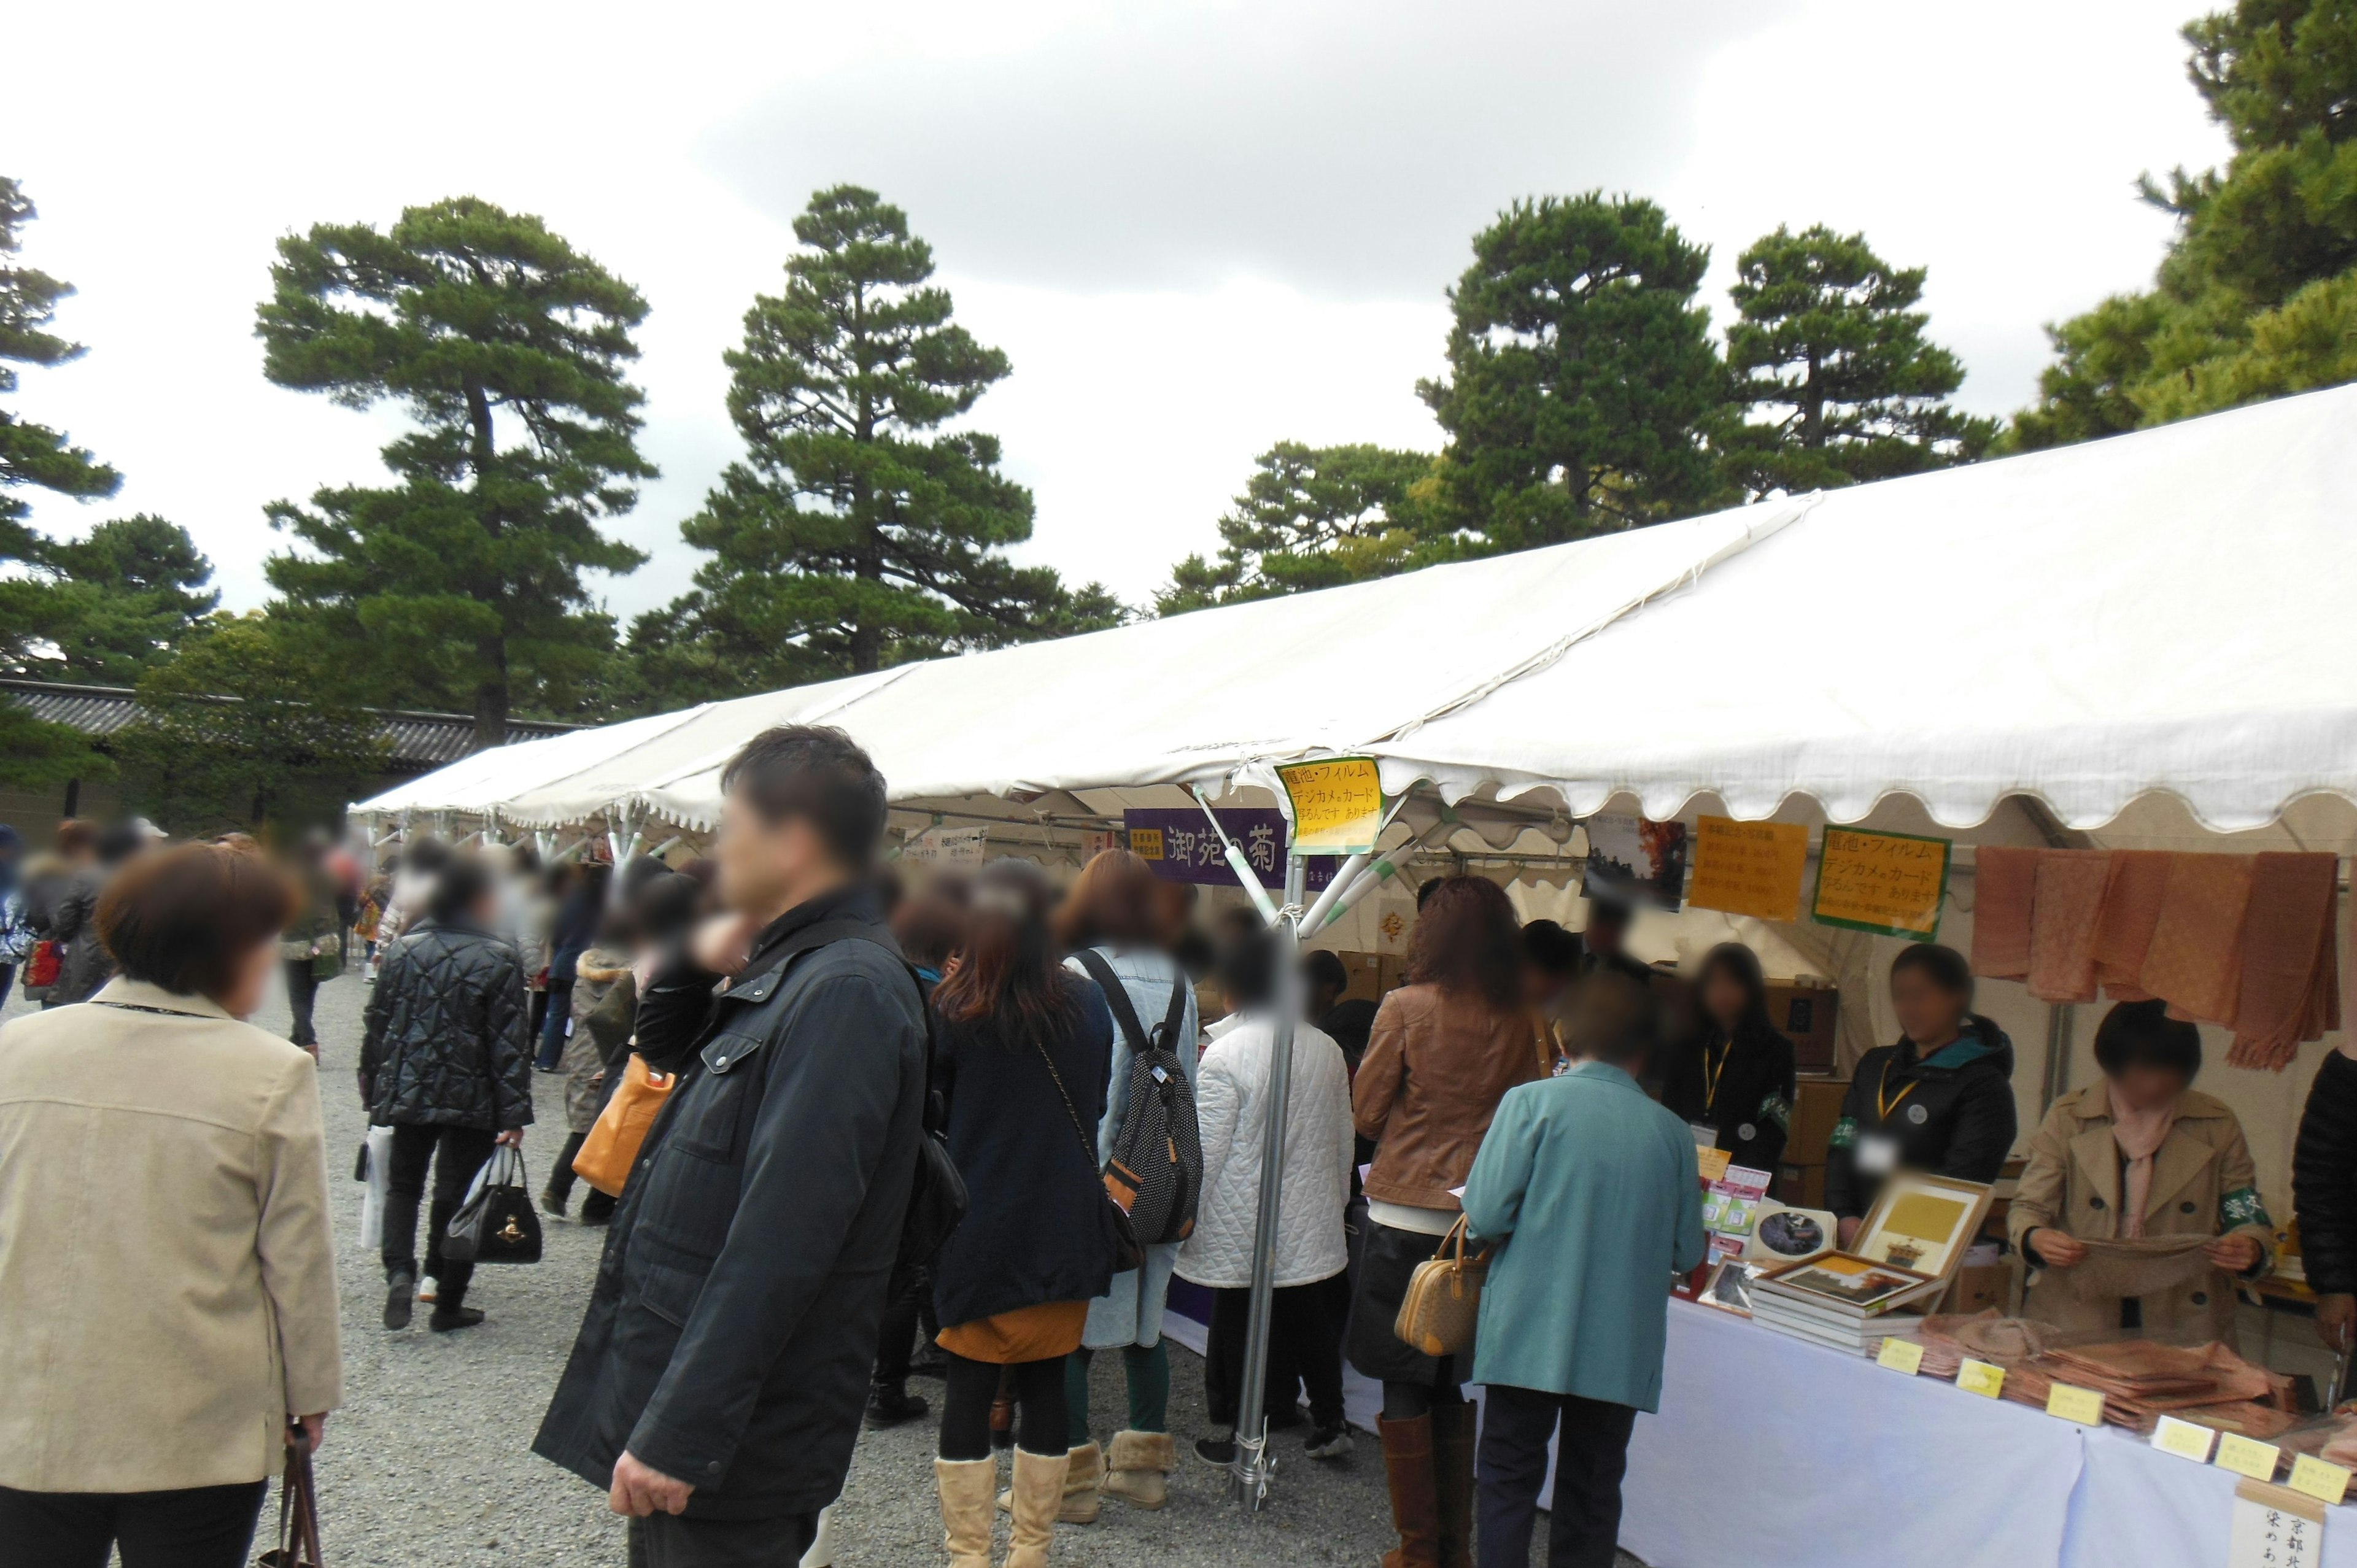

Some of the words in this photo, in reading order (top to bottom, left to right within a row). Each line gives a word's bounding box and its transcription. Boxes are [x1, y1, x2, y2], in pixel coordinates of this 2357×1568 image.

[1282, 764, 1369, 784] 電池・フィルム
[1345, 806, 1379, 820] あります
[1828, 833, 1932, 860] 電池・フィルム
[1888, 886, 1935, 904] あります
[2262, 1510, 2280, 1568] 染めあ
